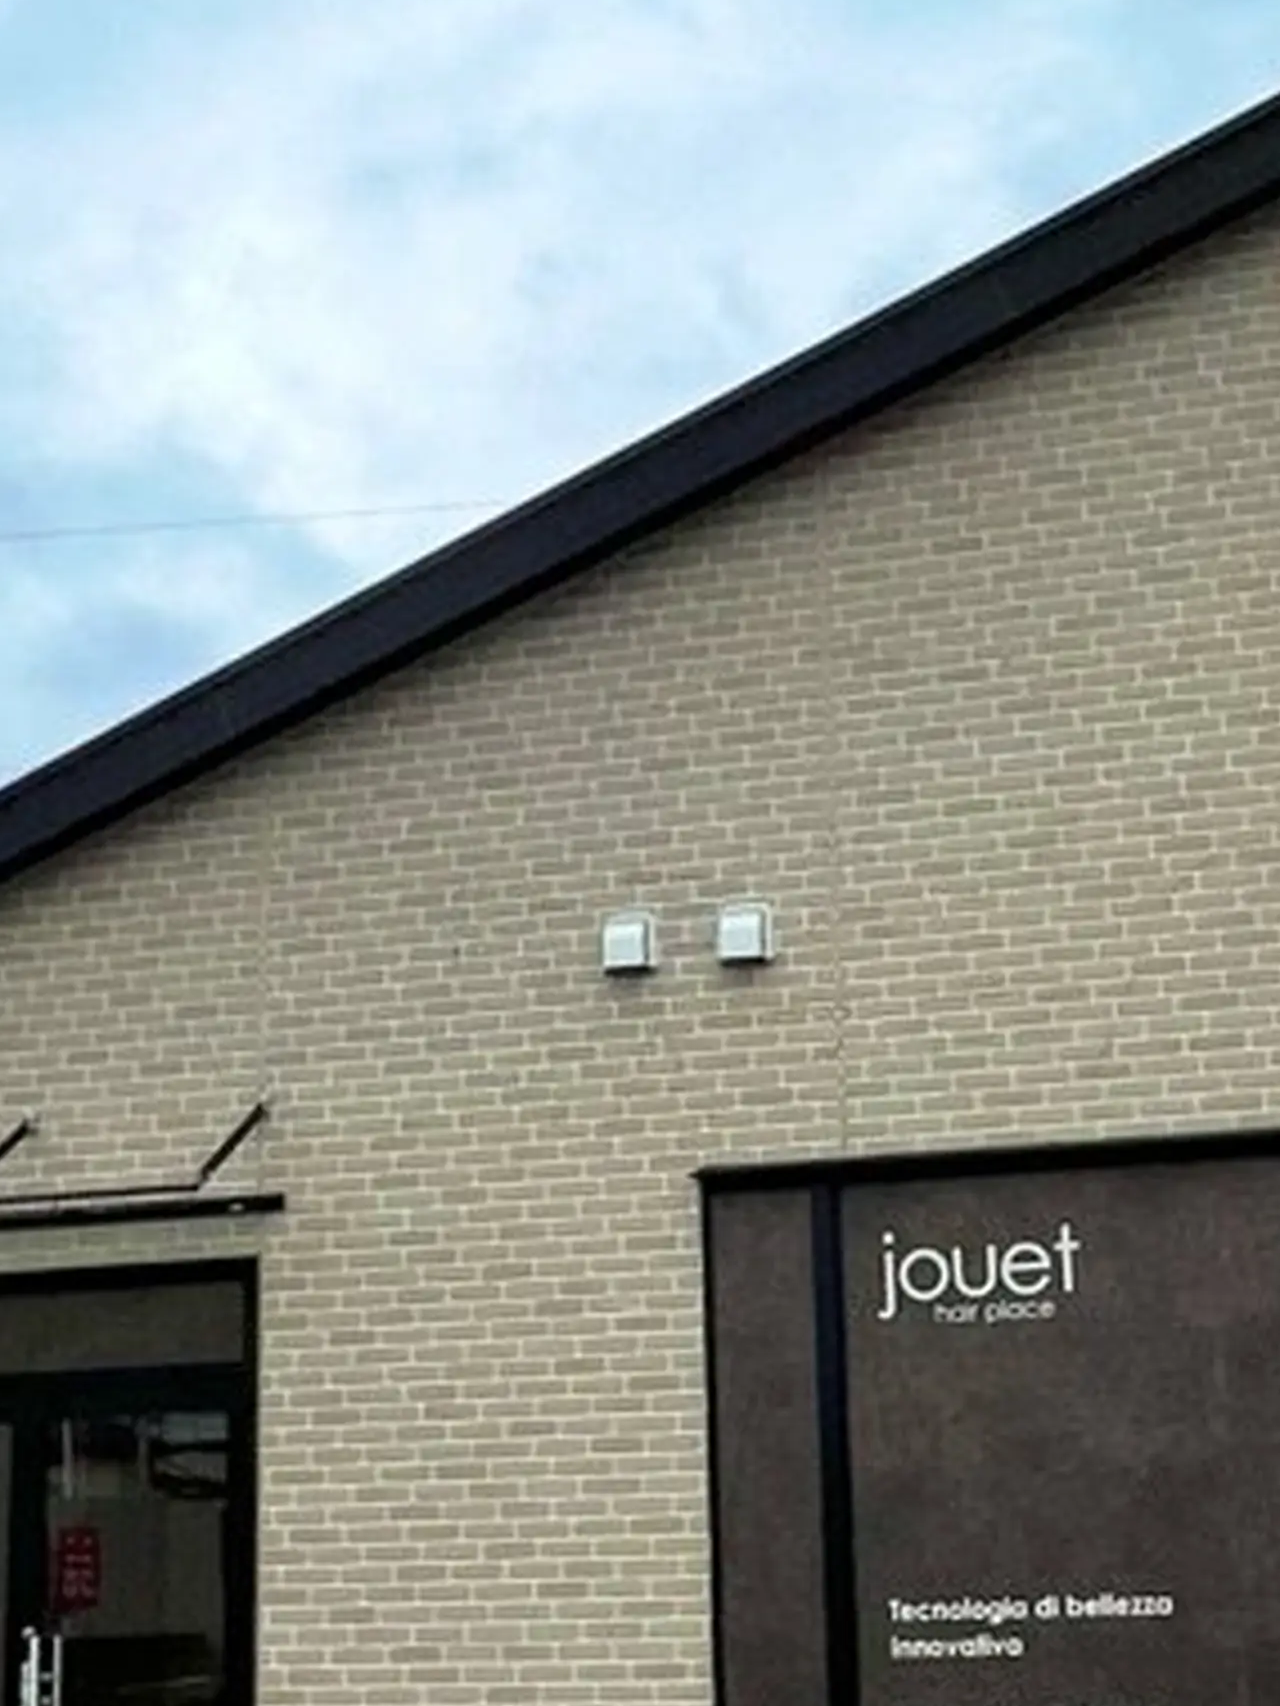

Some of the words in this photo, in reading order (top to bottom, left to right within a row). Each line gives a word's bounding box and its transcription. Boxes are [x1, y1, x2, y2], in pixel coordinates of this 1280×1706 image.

[877, 1222, 1081, 1320] jouet
[933, 1303, 980, 1323] hair
[984, 1298, 1056, 1325] place
[888, 1596, 1029, 1625] Tecnologia
[1034, 1595, 1059, 1619] di
[1065, 1592, 1174, 1618] bellezza
